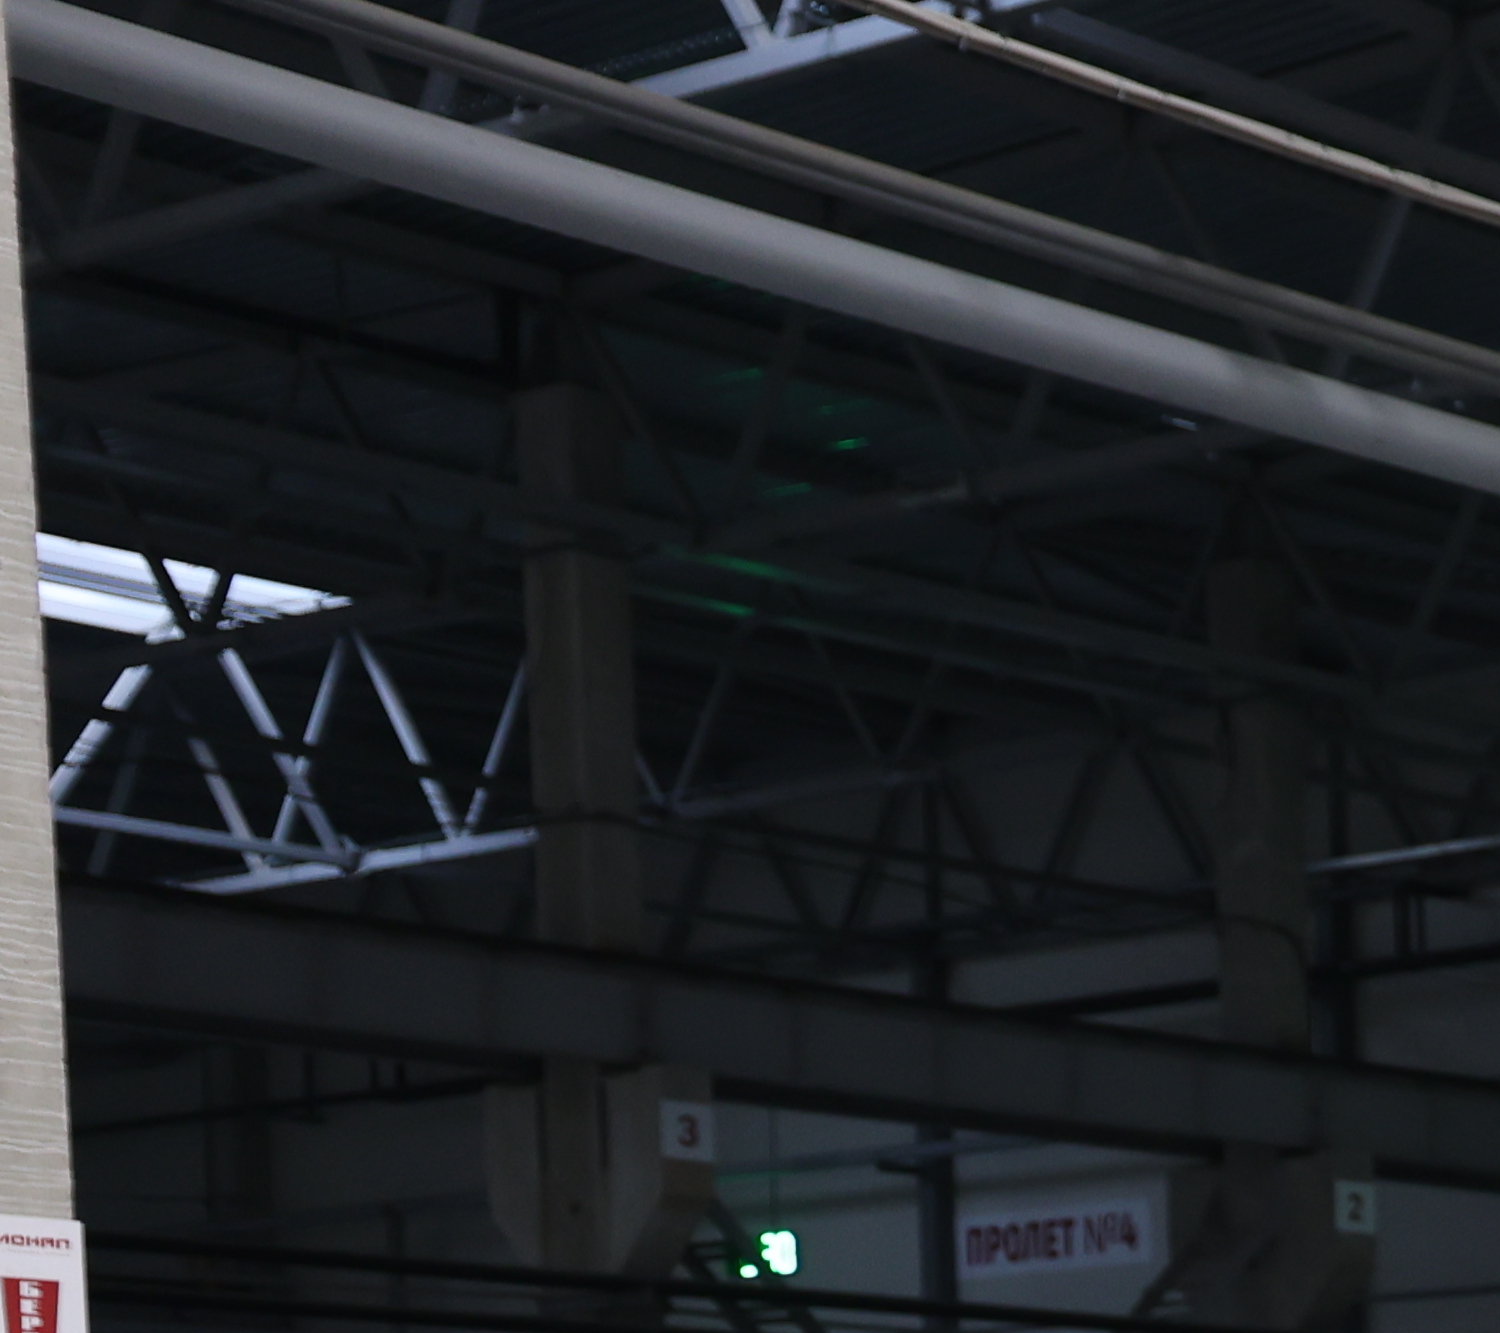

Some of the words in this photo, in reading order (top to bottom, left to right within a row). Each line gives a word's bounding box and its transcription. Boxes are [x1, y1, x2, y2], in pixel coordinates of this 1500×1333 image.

[676, 1113, 699, 1147] 3
[1347, 1191, 1366, 1223] 2
[966, 1217, 1076, 1267] ПРОЛЕТ
